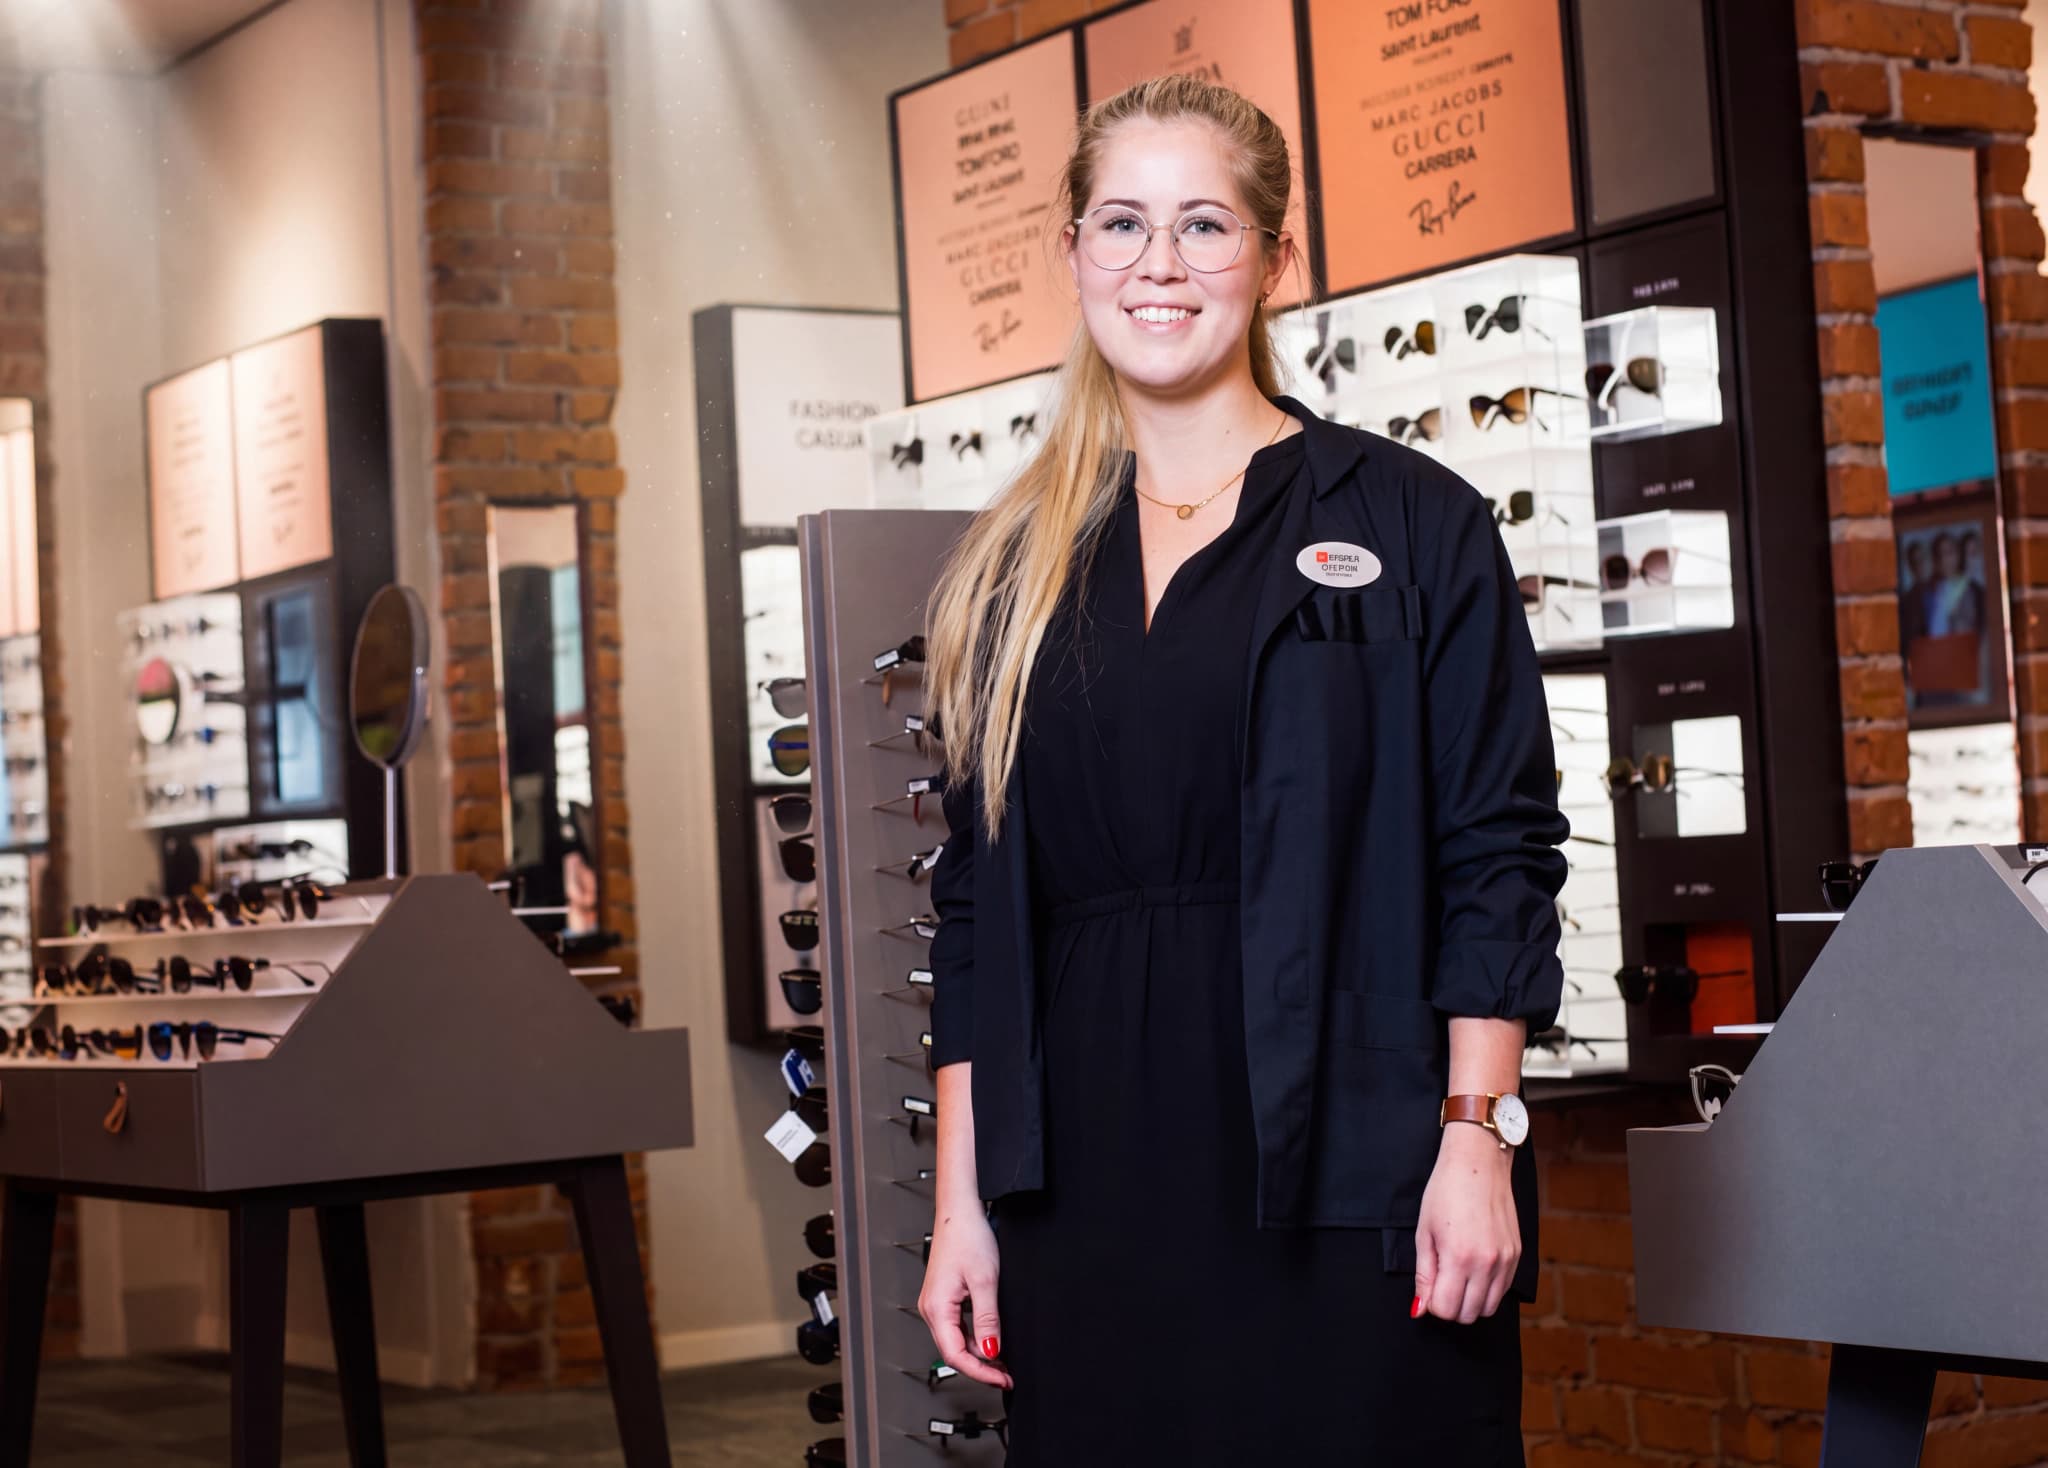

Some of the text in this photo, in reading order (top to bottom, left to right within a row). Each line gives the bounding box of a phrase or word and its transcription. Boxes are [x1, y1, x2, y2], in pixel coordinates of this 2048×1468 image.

[1384, 0, 1471, 31] TOM FO
[1371, 104, 1421, 131] MARC
[1429, 79, 1503, 116] JACOBS
[1392, 109, 1486, 157] GUCCI
[1404, 144, 1477, 180] CARRERA
